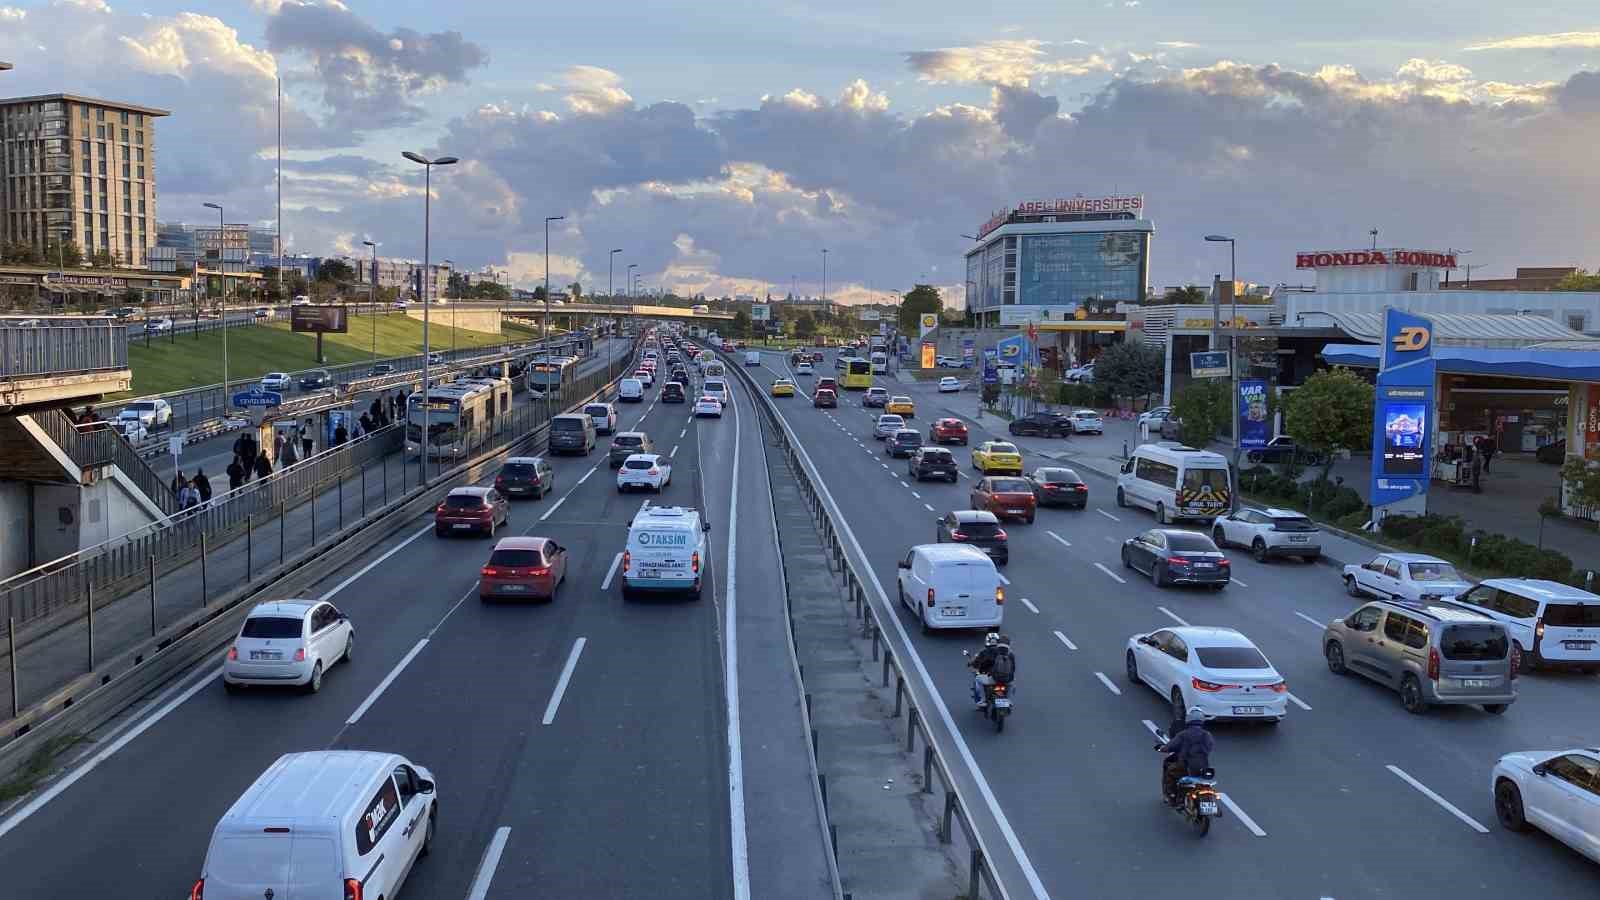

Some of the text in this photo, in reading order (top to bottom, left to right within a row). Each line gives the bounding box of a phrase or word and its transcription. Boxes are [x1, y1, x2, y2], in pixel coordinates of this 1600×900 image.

[1296, 251, 1390, 268] HONDA
[1395, 251, 1457, 267] HONDA
[1241, 385, 1263, 396] VAR
[651, 532, 686, 545] TAKSİM
